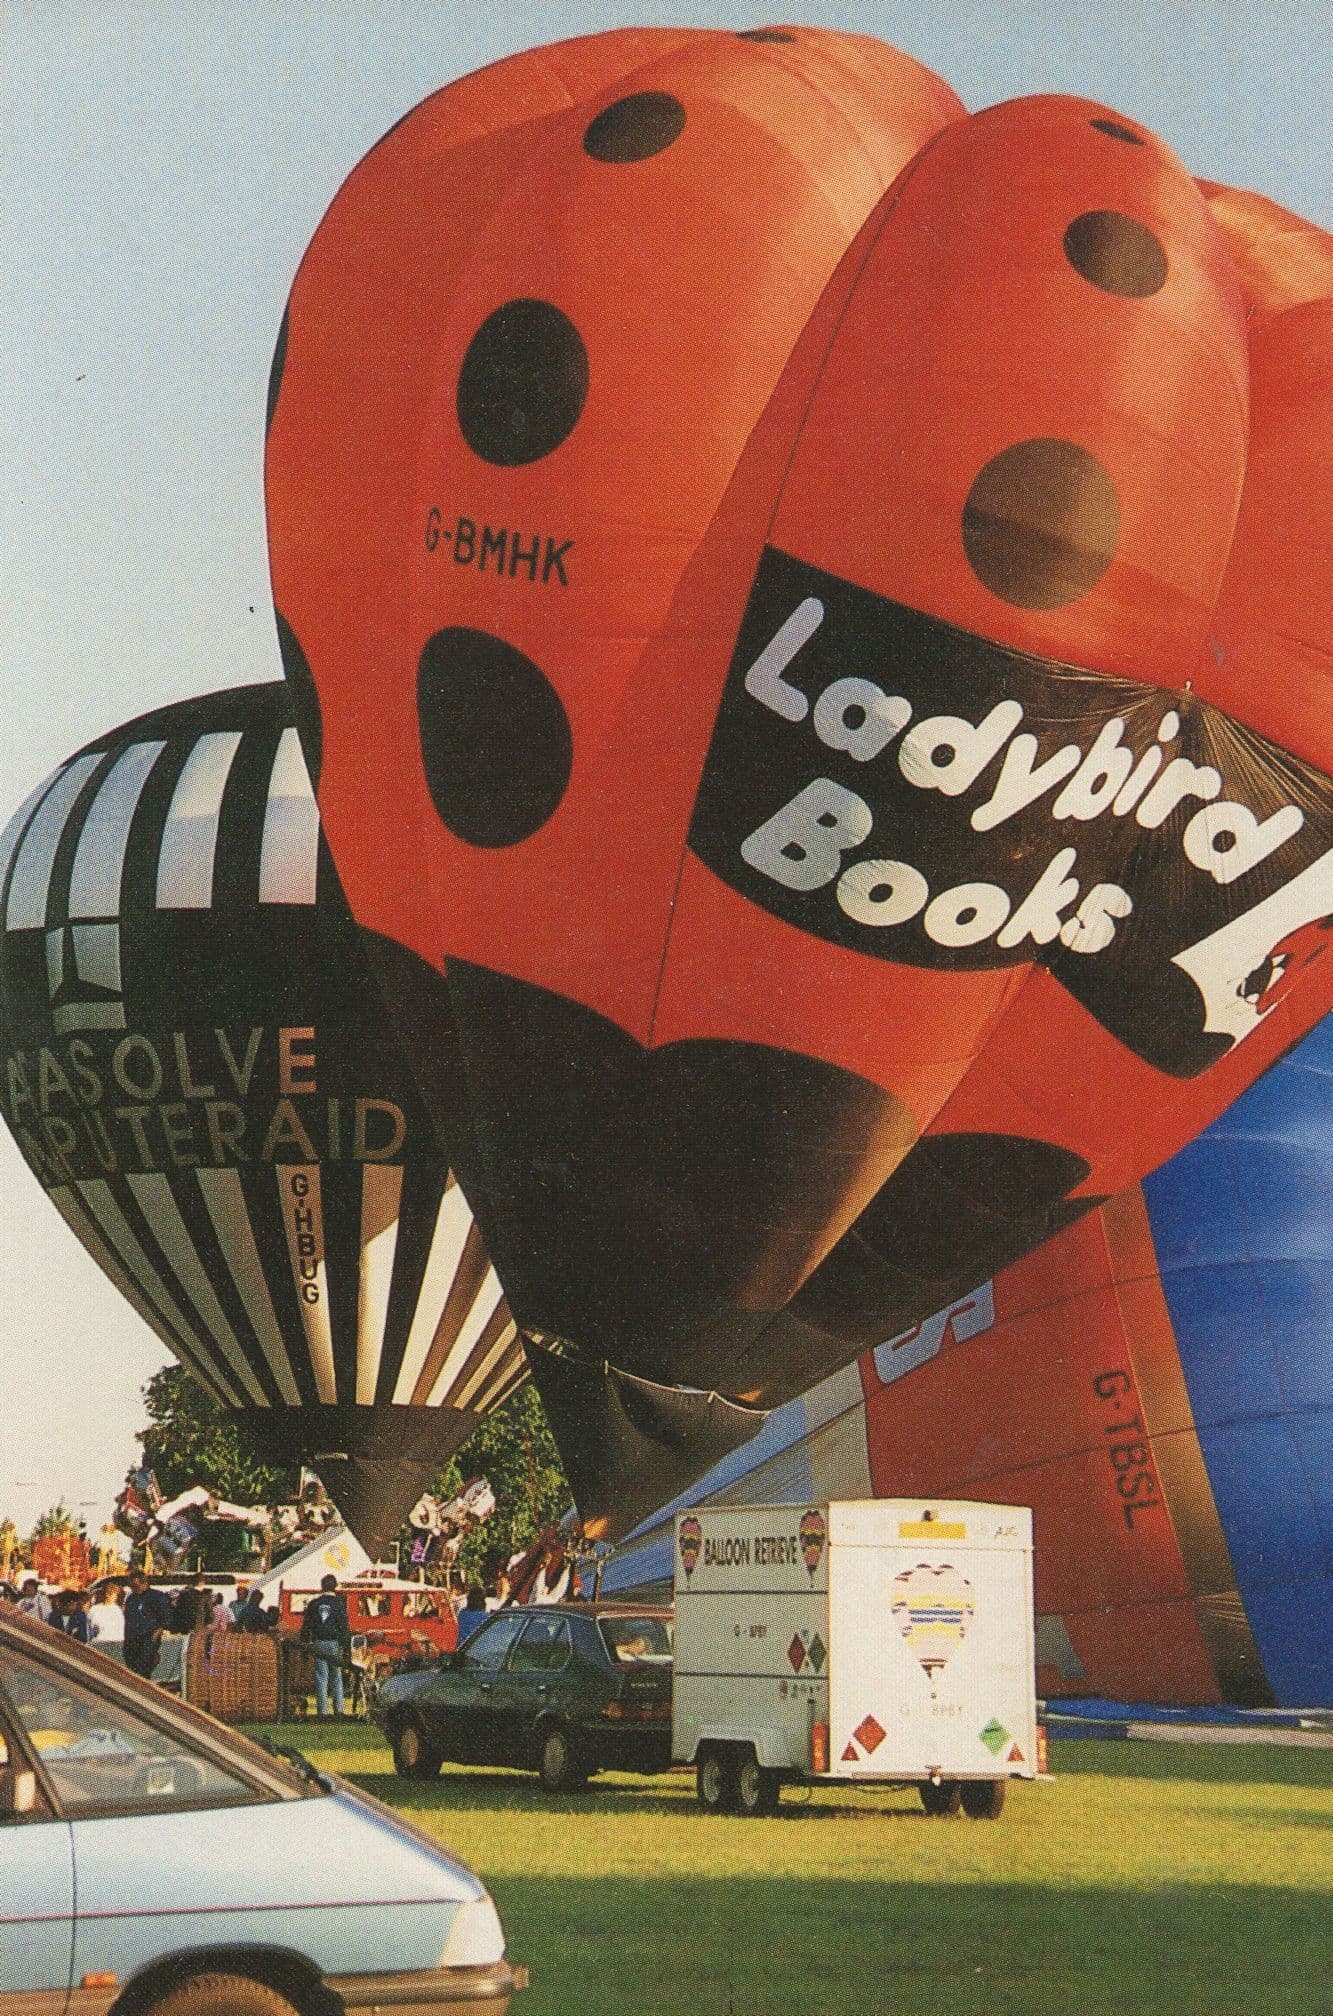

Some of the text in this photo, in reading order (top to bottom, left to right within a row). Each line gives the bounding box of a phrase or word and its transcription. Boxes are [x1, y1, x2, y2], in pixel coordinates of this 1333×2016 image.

[425, 507, 576, 586] G-BMHK
[744, 597, 1304, 885] Ladybird
[740, 777, 1132, 954] Books
[1093, 1370, 1160, 1530] G-TBSL
[704, 1538, 750, 1566] BALLOON
